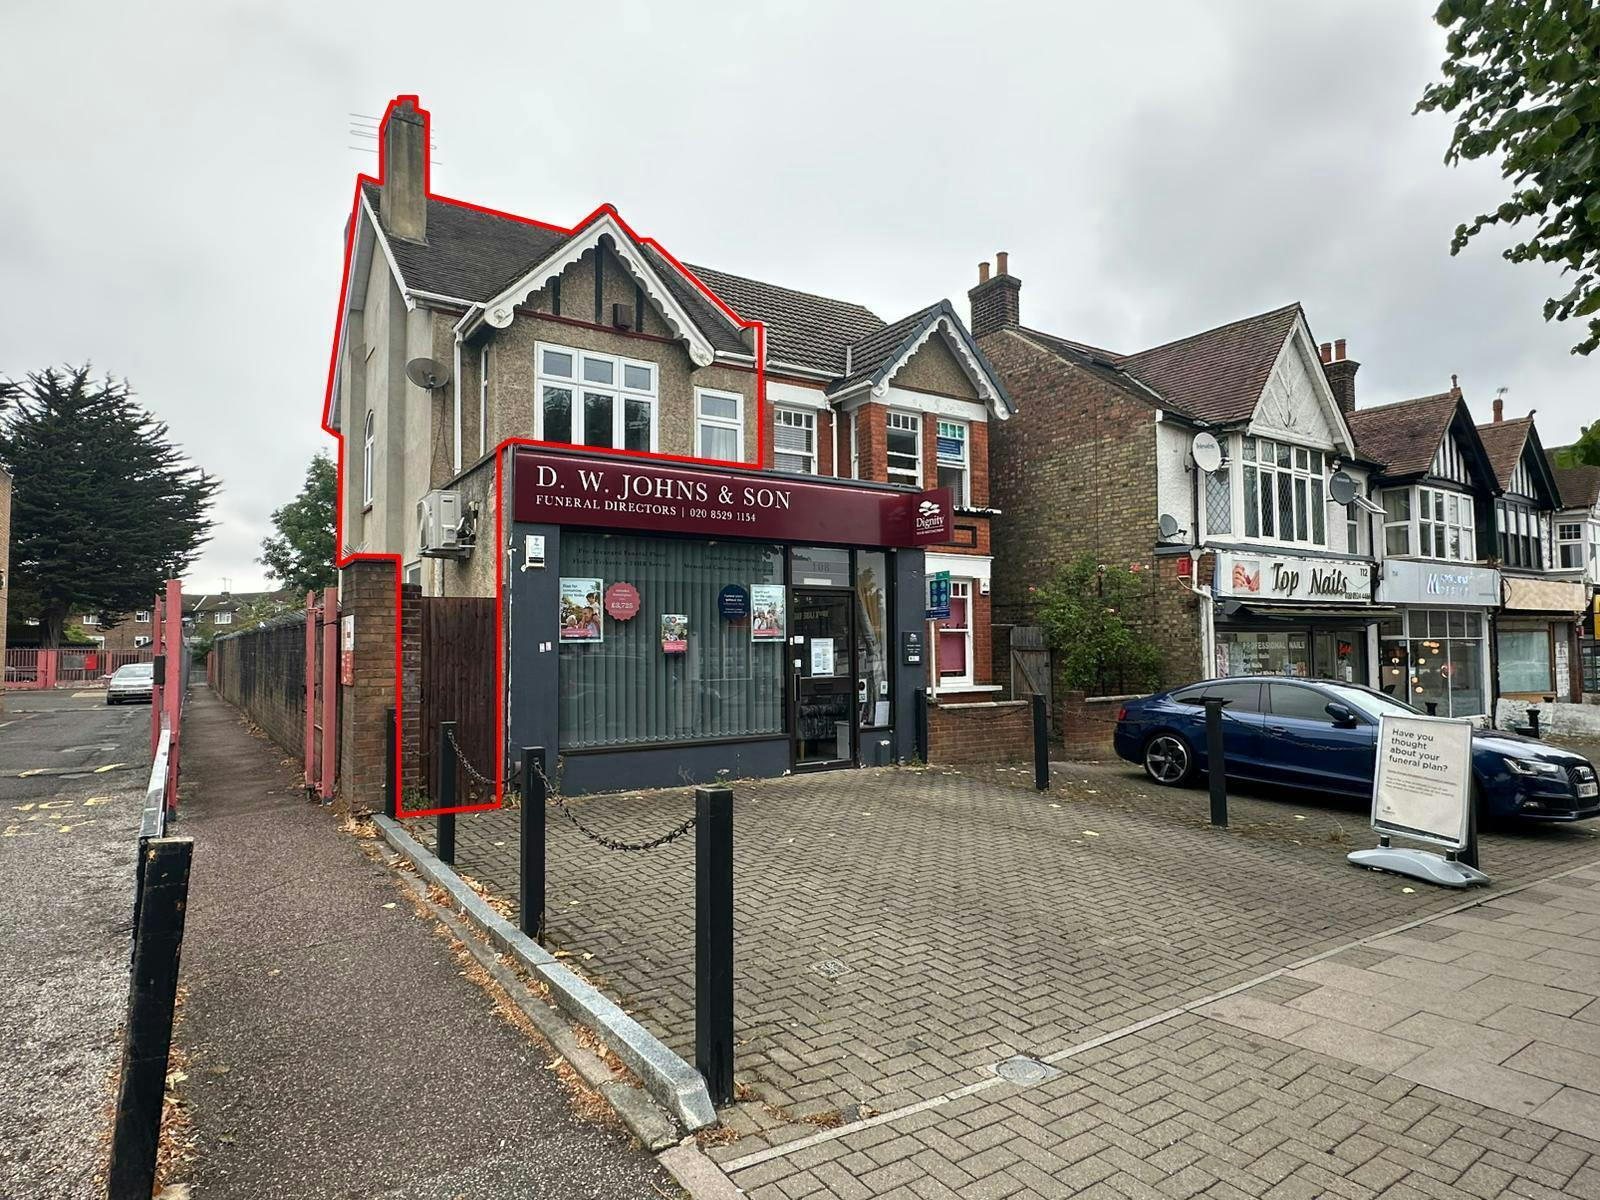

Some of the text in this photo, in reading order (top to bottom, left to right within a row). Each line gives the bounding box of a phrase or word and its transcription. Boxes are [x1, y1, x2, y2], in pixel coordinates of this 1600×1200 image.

[536, 465, 792, 510] D. W. JOHNS & SON
[536, 494, 756, 523] FUNERAL DIRECTORS 020 8529 1154
[916, 516, 945, 530] Dignity
[1270, 562, 1348, 597] Top Nails
[1359, 568, 1368, 577] 112
[1243, 641, 1305, 650] PROFESSIONAL NAILS
[1392, 728, 1434, 743] Have you
[1391, 737, 1428, 750] thought
[1390, 746, 1440, 762] about your
[1388, 755, 1448, 773] funeral plan?
